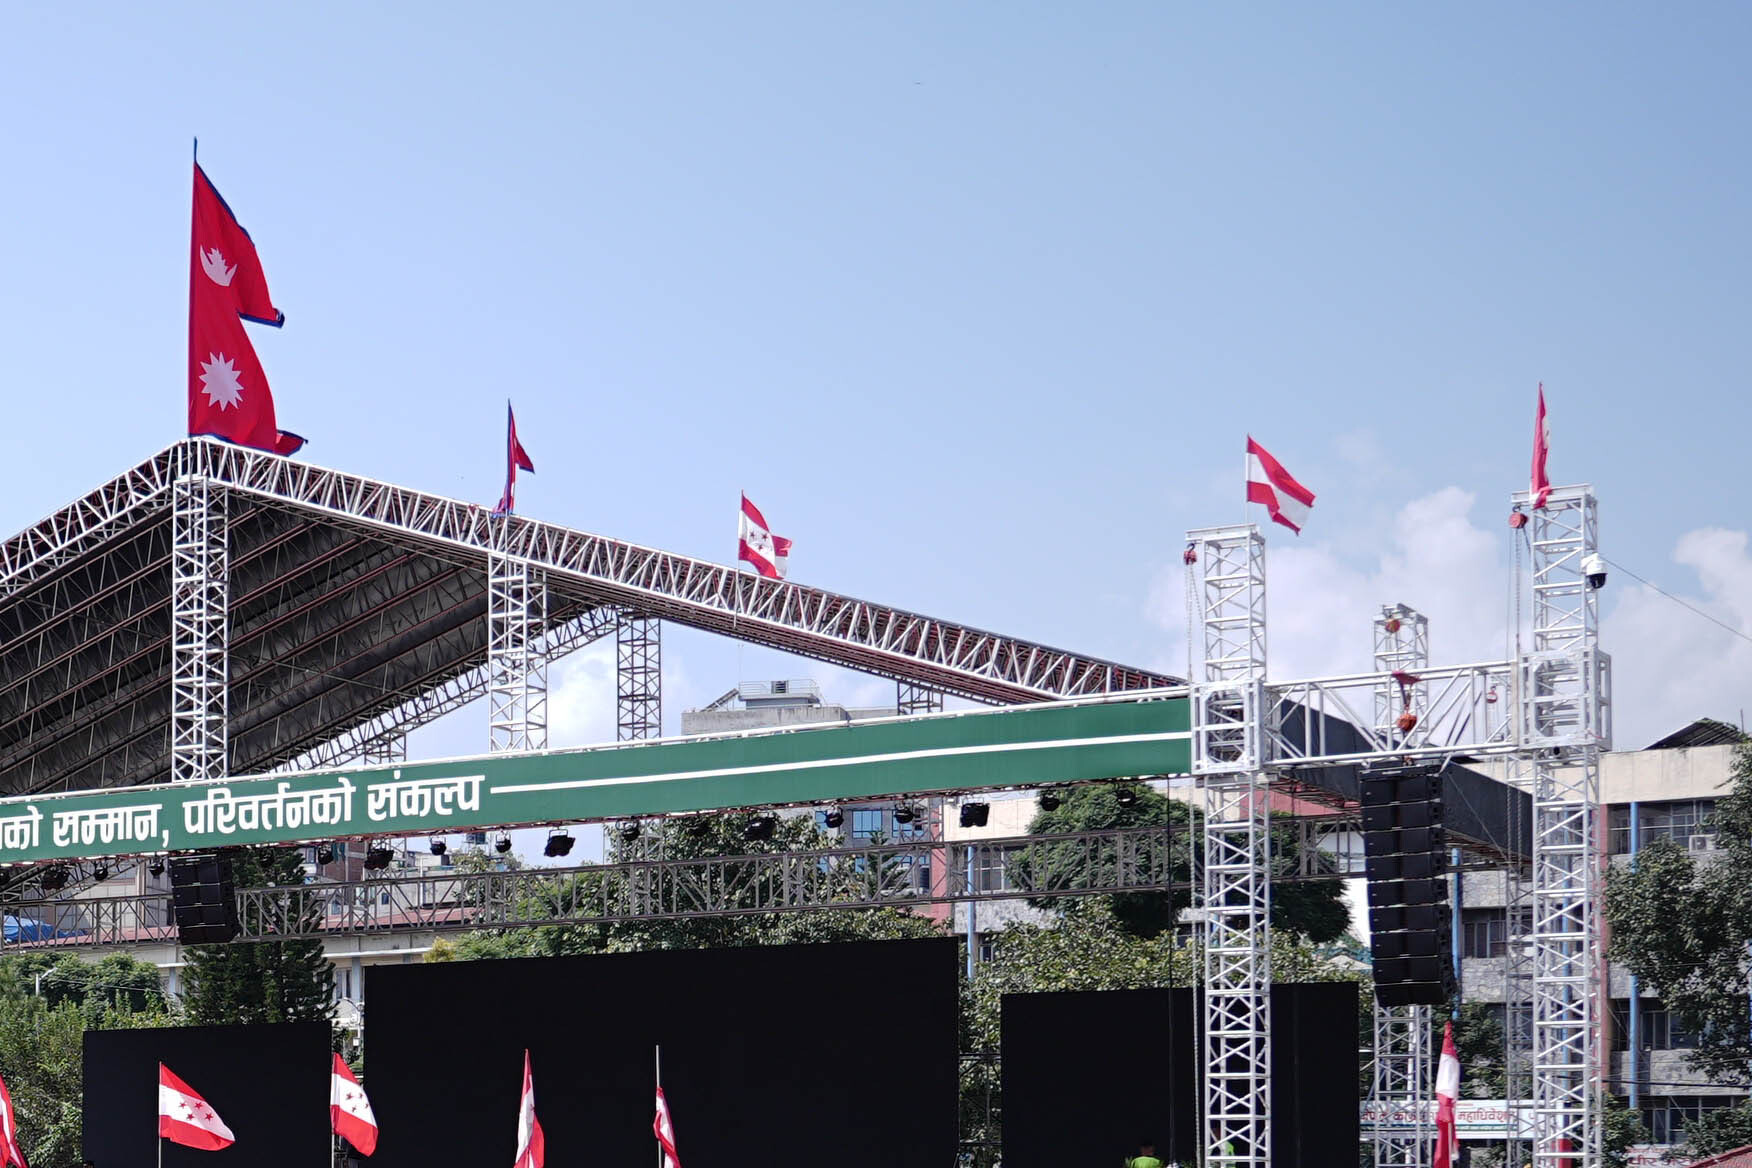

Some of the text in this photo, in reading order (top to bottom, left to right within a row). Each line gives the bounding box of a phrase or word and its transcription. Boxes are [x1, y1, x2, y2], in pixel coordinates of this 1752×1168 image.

[52, 803, 169, 848] सम्मान,
[182, 776, 356, 834] परिवर्तनको
[367, 768, 486, 821] संकल्प
